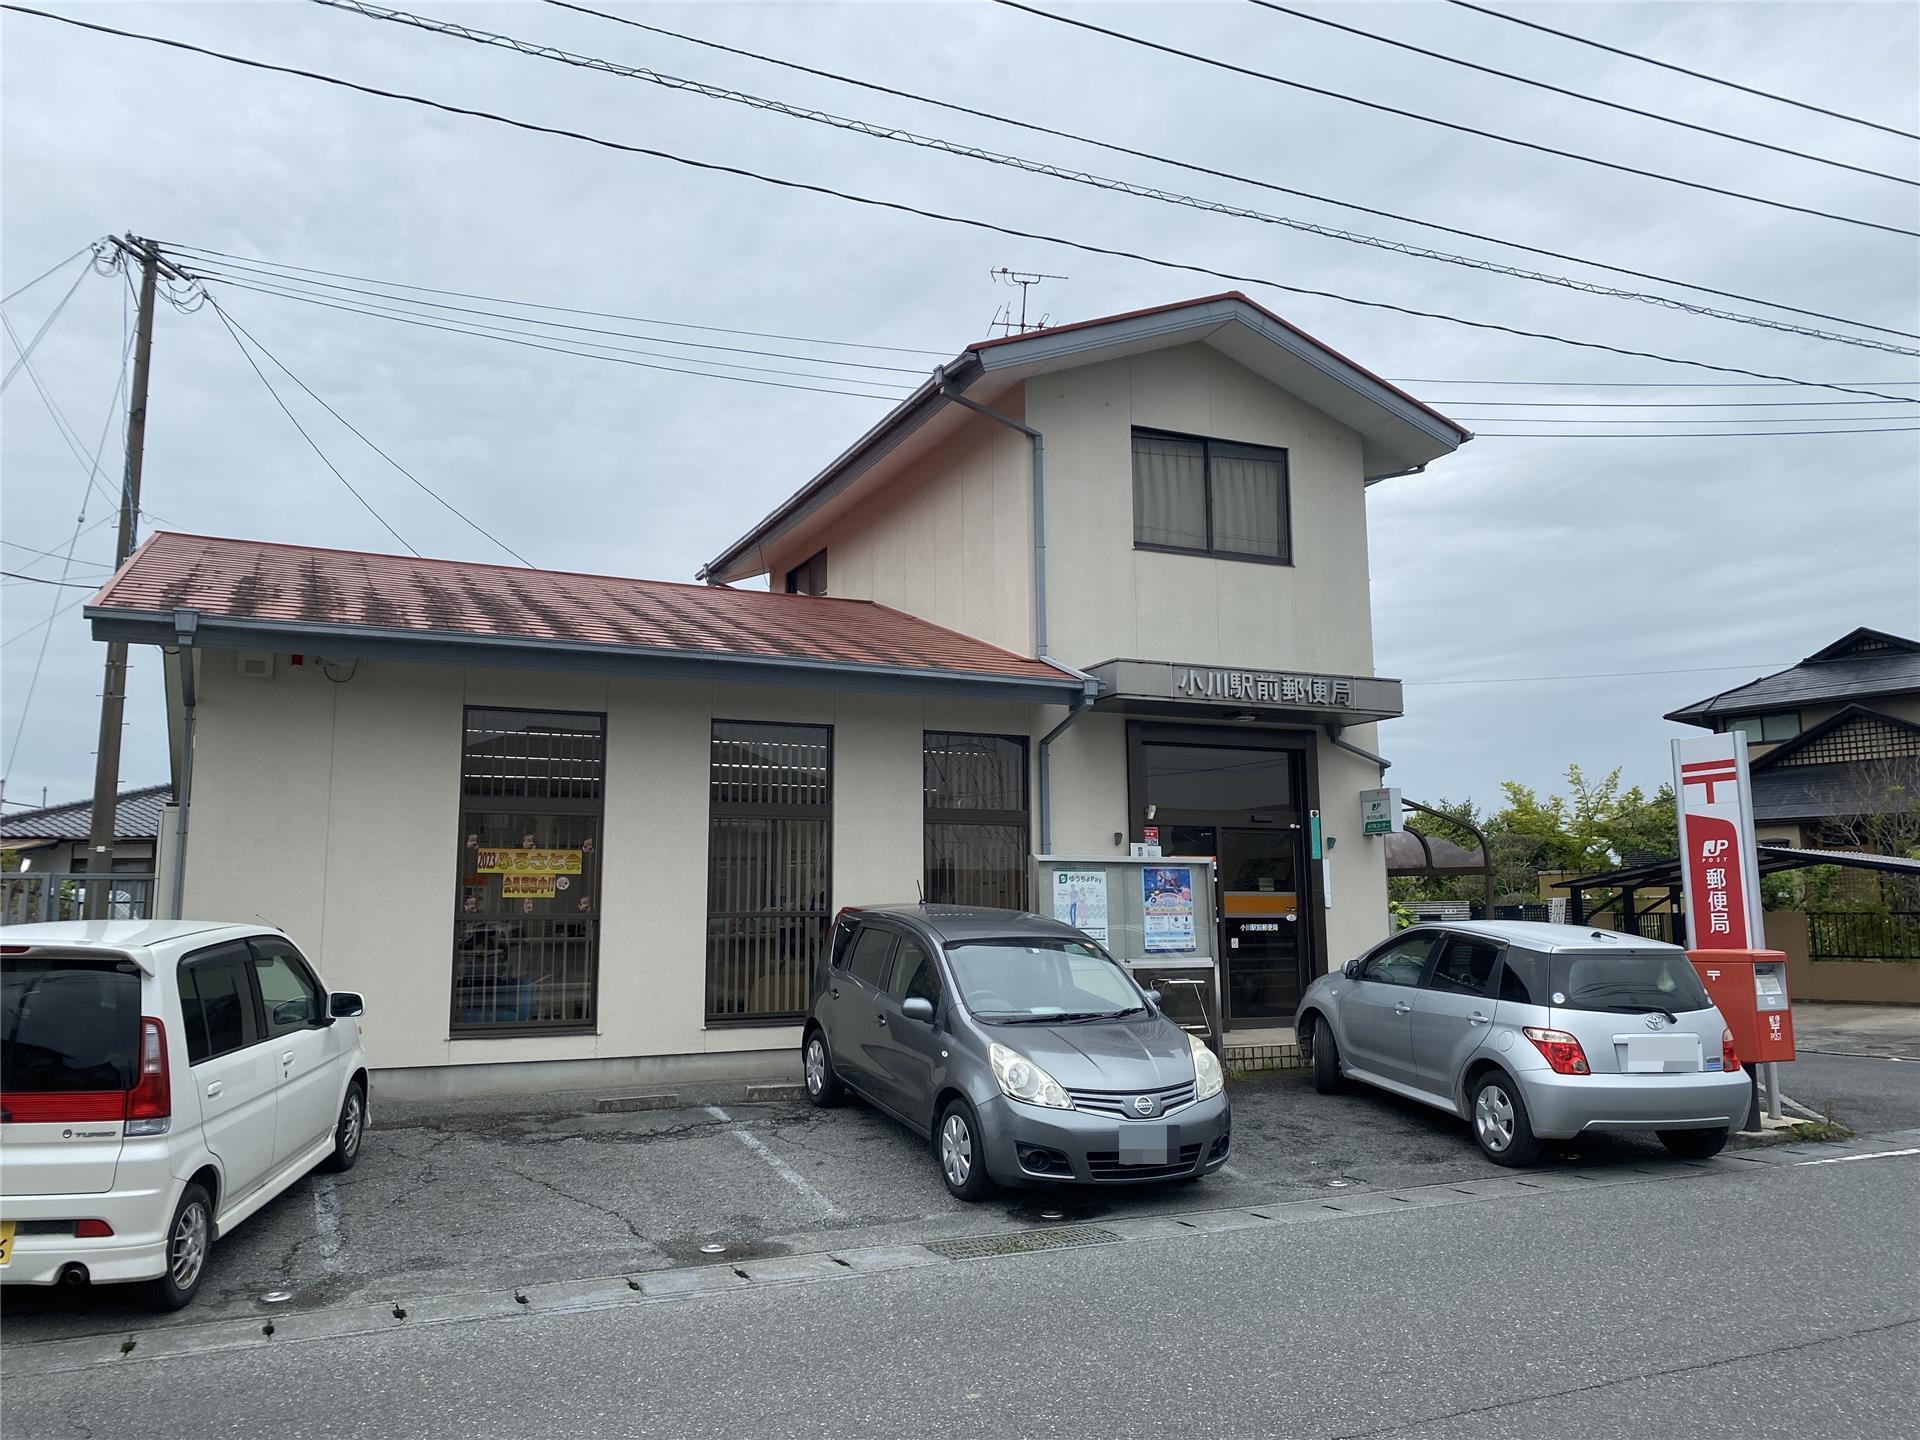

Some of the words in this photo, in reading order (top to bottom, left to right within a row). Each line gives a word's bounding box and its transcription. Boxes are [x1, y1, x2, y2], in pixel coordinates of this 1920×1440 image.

[1179, 669, 1351, 706] 小川駅前郵便局
[477, 851, 581, 871] 2023ふるさと会
[1069, 874, 1103, 884] ゆうちょPay
[1706, 867, 1730, 934] 郵便局
[1770, 1032, 1782, 1041] POST
